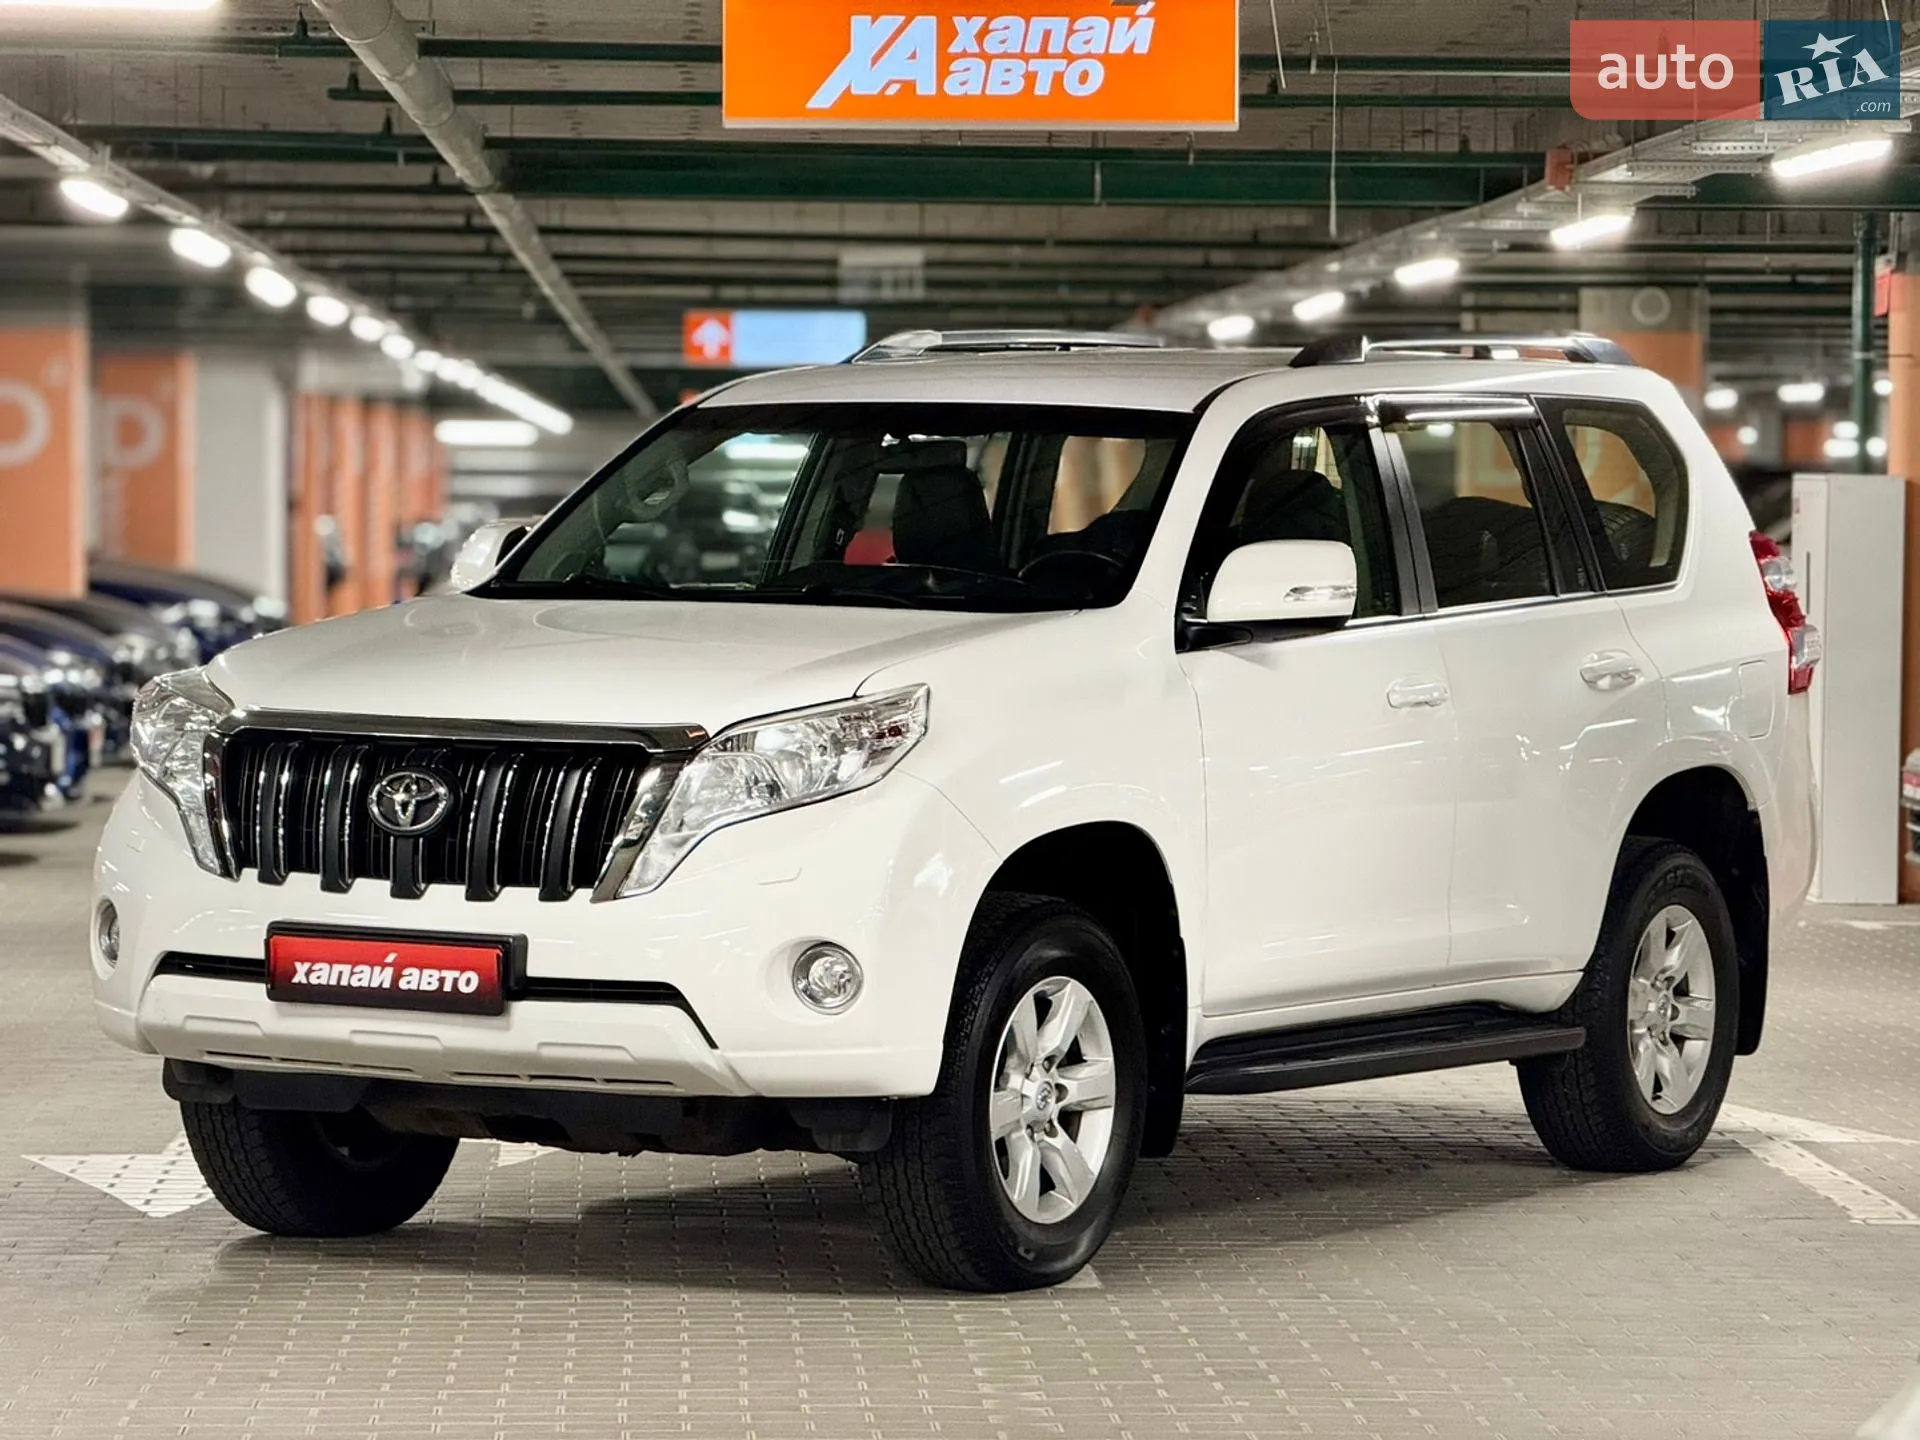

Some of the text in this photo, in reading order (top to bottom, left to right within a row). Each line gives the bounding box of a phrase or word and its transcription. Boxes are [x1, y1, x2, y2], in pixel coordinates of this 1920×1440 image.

[947, 1, 1155, 55] хапай
[943, 58, 1105, 96] авто
[291, 952, 479, 994] хапай авто
